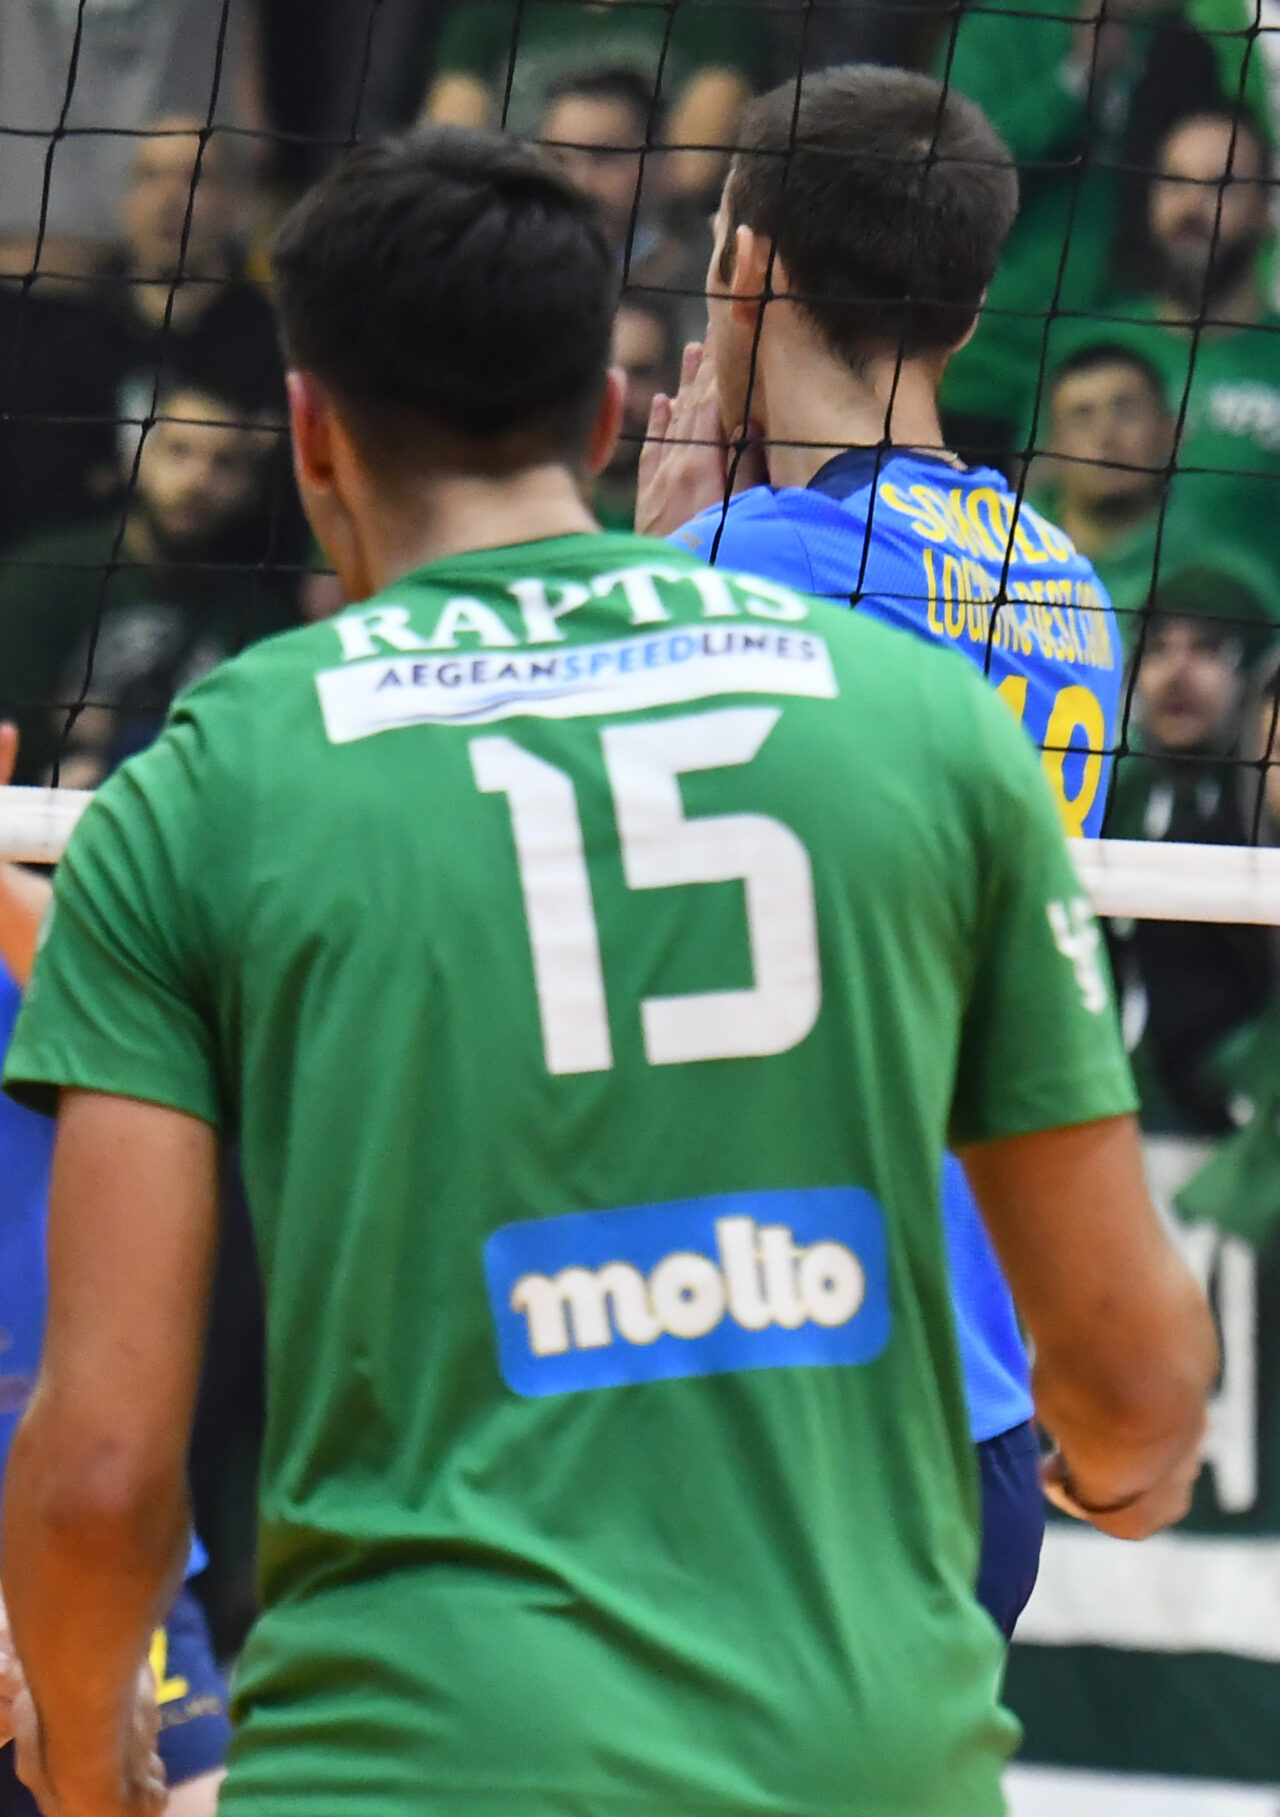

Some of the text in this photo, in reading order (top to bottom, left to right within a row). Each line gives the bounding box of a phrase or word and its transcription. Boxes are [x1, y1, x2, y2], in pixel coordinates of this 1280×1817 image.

[334, 564, 808, 662] RAPTIS
[468, 706, 820, 1075] 15
[511, 1216, 866, 1357] molto
